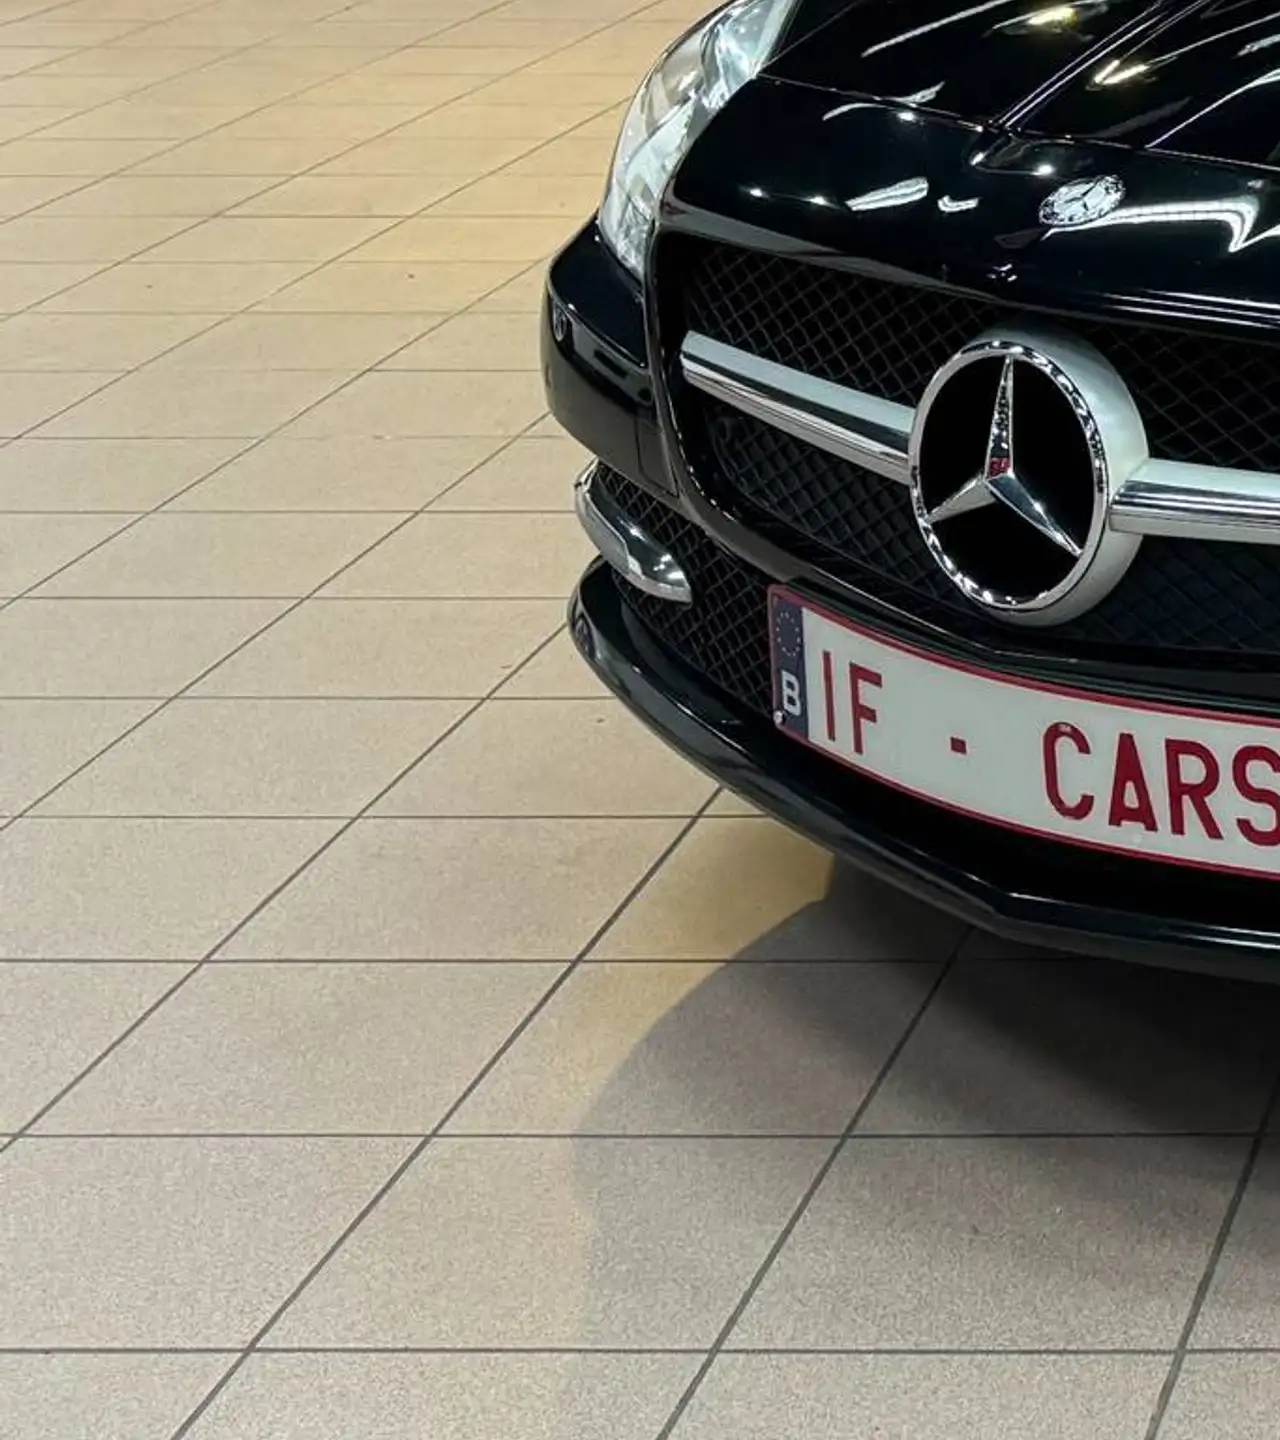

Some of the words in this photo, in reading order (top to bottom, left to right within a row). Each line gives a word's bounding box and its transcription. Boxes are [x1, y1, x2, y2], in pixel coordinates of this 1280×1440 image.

[781, 670, 804, 717] B
[822, 650, 883, 755] IF
[950, 736, 967, 755] -
